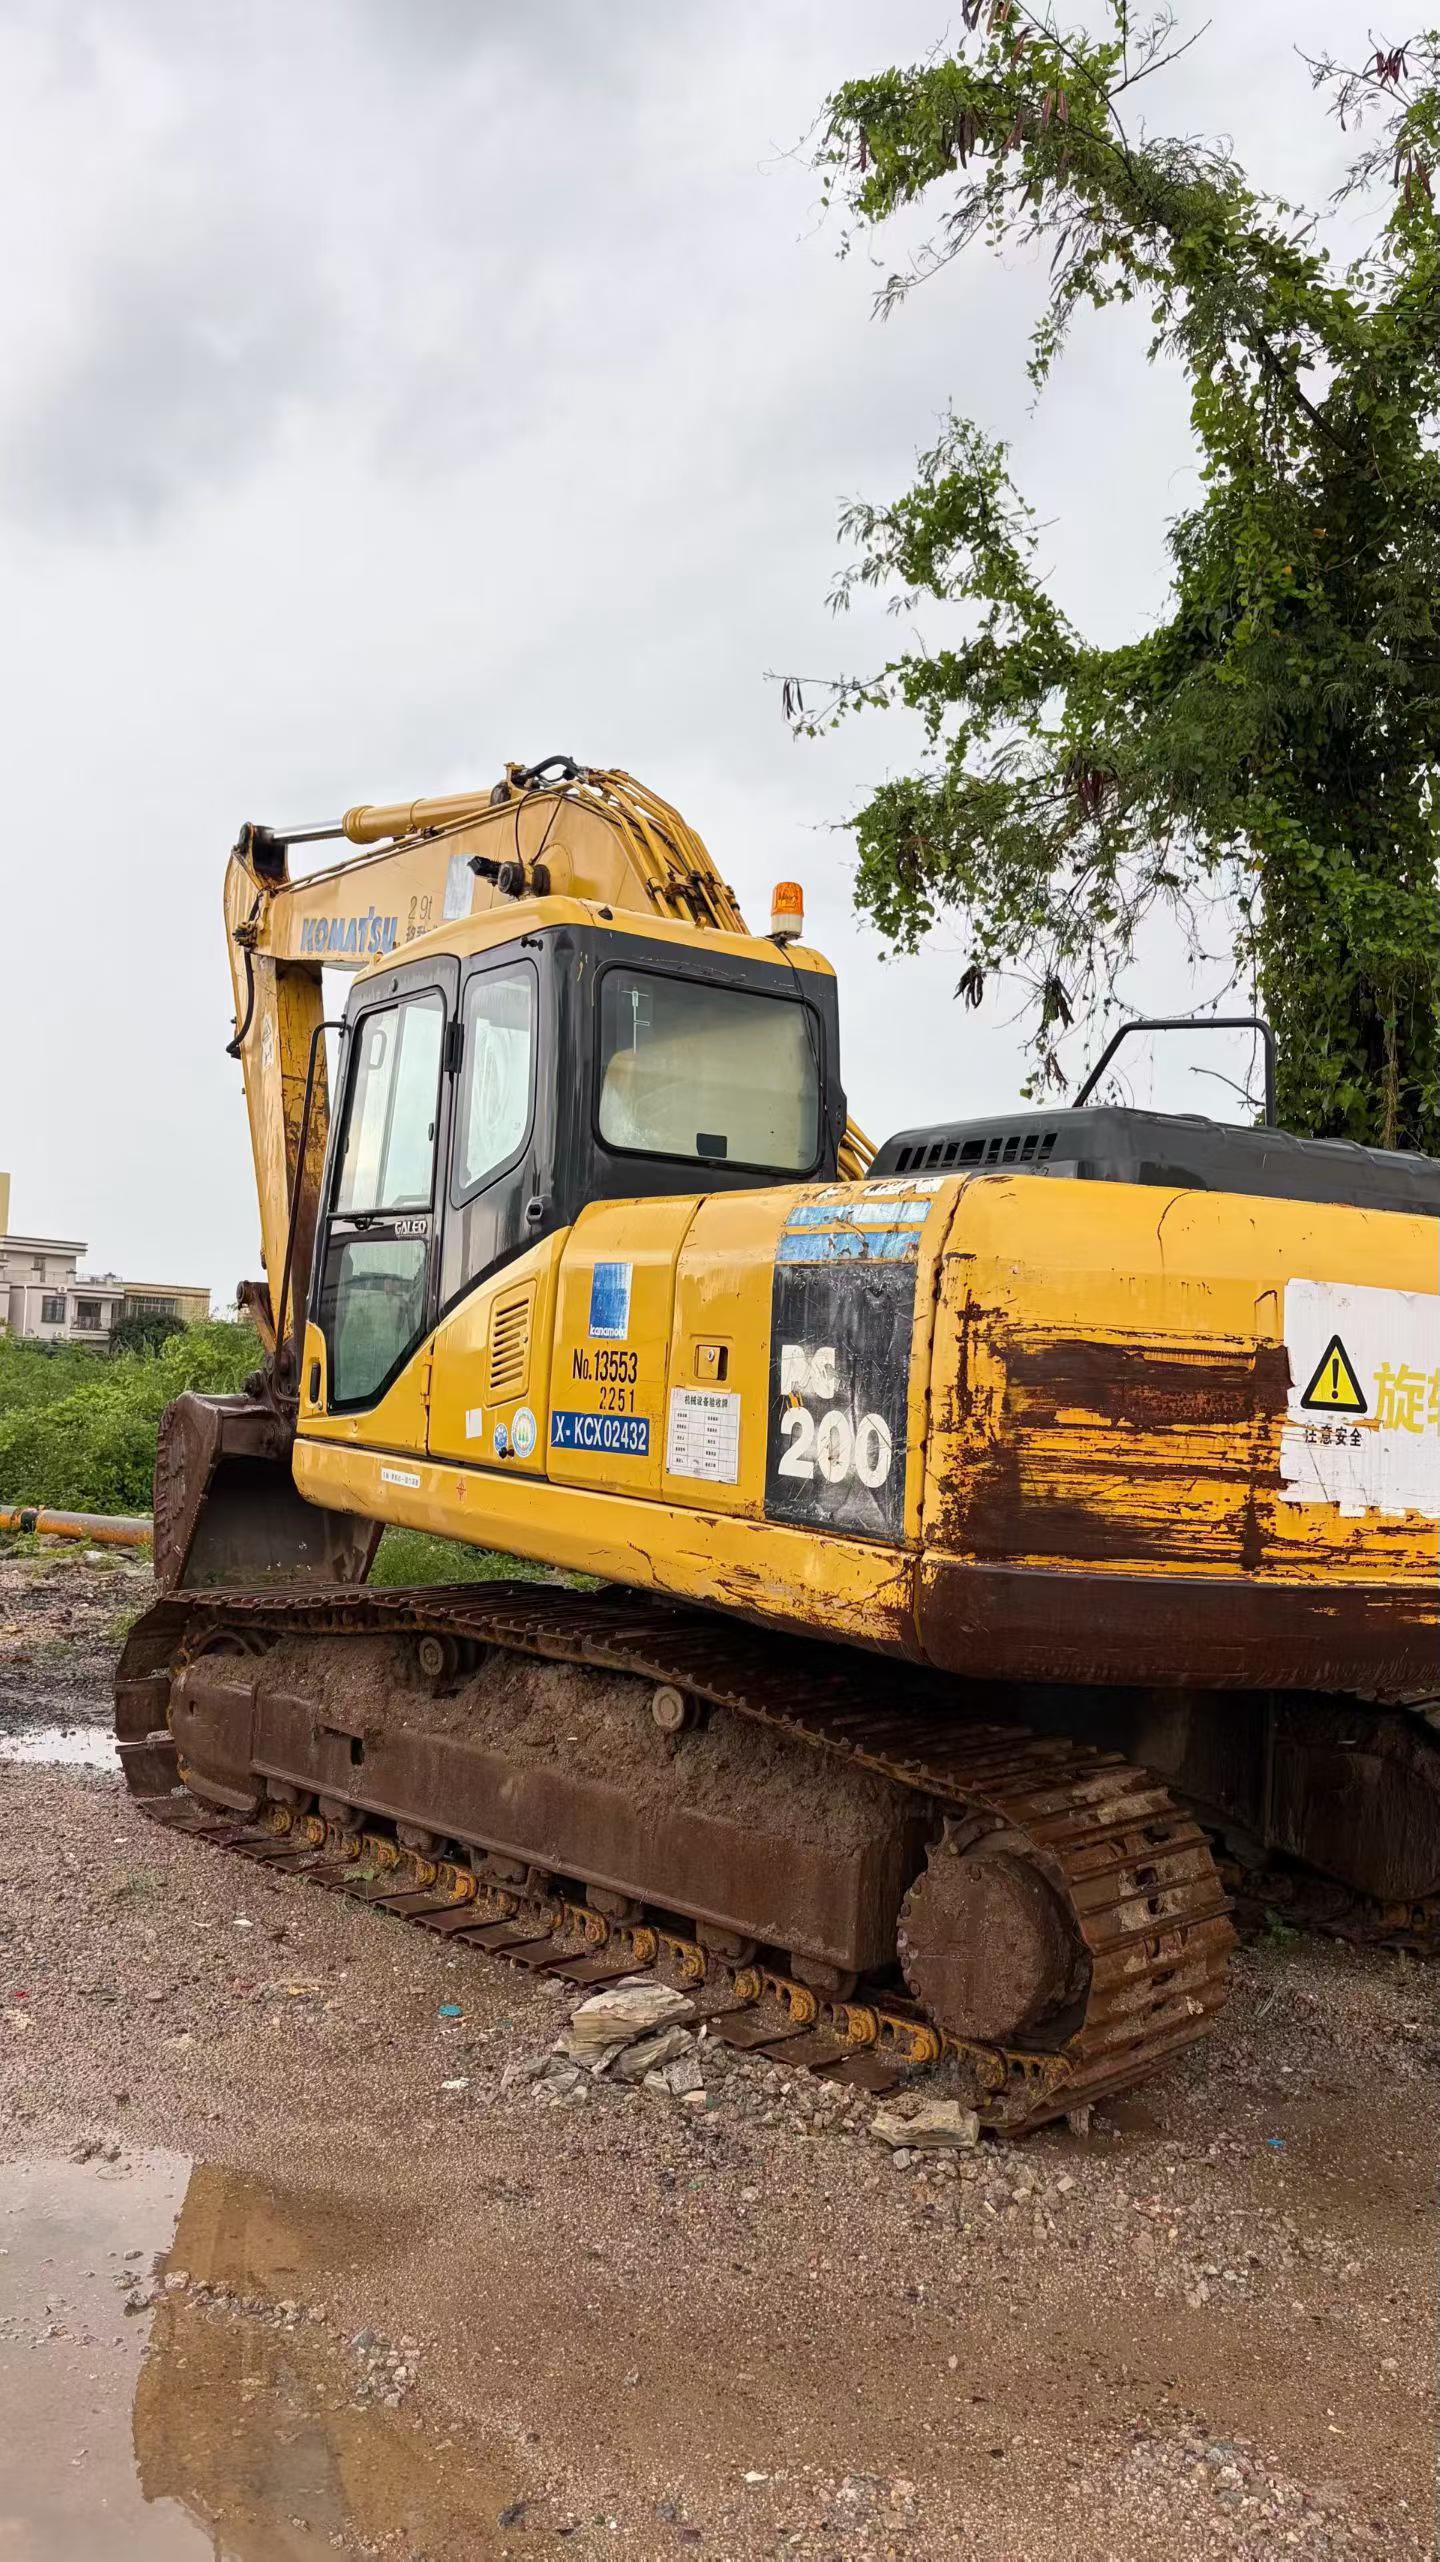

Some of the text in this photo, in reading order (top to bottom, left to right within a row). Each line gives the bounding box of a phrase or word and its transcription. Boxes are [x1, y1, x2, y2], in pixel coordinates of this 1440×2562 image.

[300, 906, 398, 954] KOMATSU
[394, 1220, 427, 1234] GALEO
[1373, 1361, 1440, 1436] 旋
[778, 1406, 892, 1489] 200
[1304, 1424, 1362, 1447] 注意安全
